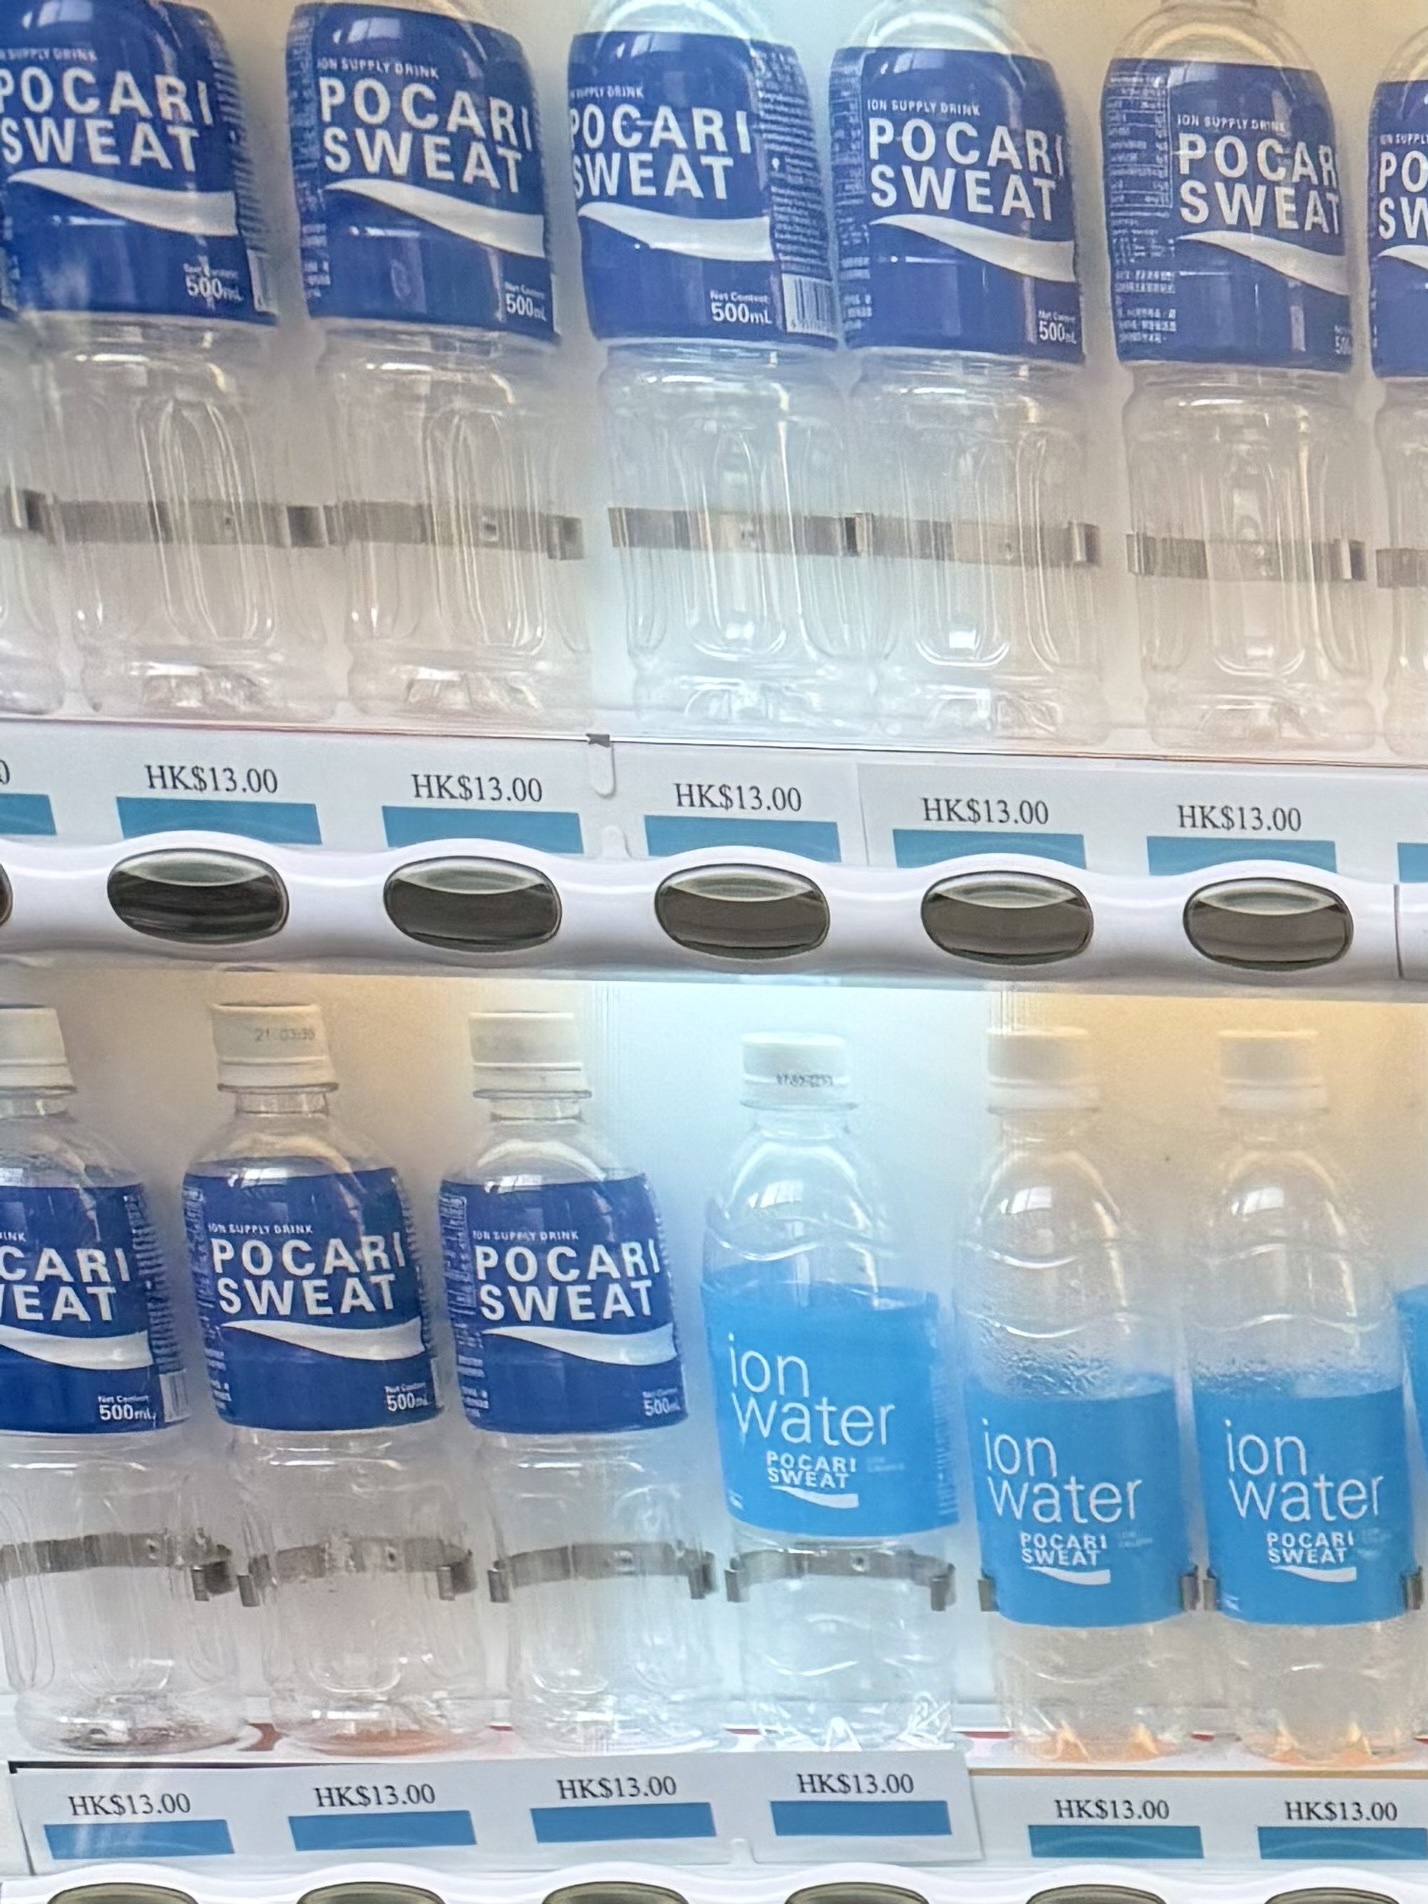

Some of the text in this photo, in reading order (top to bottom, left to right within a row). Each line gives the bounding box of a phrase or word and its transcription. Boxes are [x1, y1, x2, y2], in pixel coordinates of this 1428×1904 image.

[320, 78, 531, 157] POCARI
[0, 117, 198, 171] SWEAT
[324, 127, 521, 192] SWEAT
[869, 112, 1063, 183] POCARI
[871, 165, 1055, 220] SWEAT
[711, 302, 772, 324] 500mL
[145, 765, 278, 793] HK$13.00
[412, 774, 542, 802] HK$13.00
[675, 783, 801, 812] HK$13.00
[922, 798, 1048, 824] HK$13.00
[1178, 805, 1301, 831] HK$13.00
[0, 1246, 129, 1282] CARI
[211, 1226, 404, 1276] POCARI
[476, 1240, 659, 1281] POCARI
[218, 1274, 394, 1315] SWEAT
[480, 1279, 651, 1320] SWEAT
[728, 1333, 809, 1397] ion
[732, 1393, 894, 1446] water
[766, 1451, 856, 1473] POCARI
[982, 1418, 1057, 1477] ion
[1225, 1419, 1307, 1475] ion
[767, 1468, 849, 1490] SWEAT
[1229, 1474, 1383, 1522] water
[988, 1476, 1142, 1523] water
[314, 1784, 435, 1807] HK$13.00
[557, 1776, 676, 1799] HK$13.00
[797, 1774, 914, 1794] HK$13.00
[68, 1793, 191, 1816] HK$13.00
[1055, 1799, 1169, 1819] HK$13.00
[1285, 1801, 1397, 1821] HK$13.00
